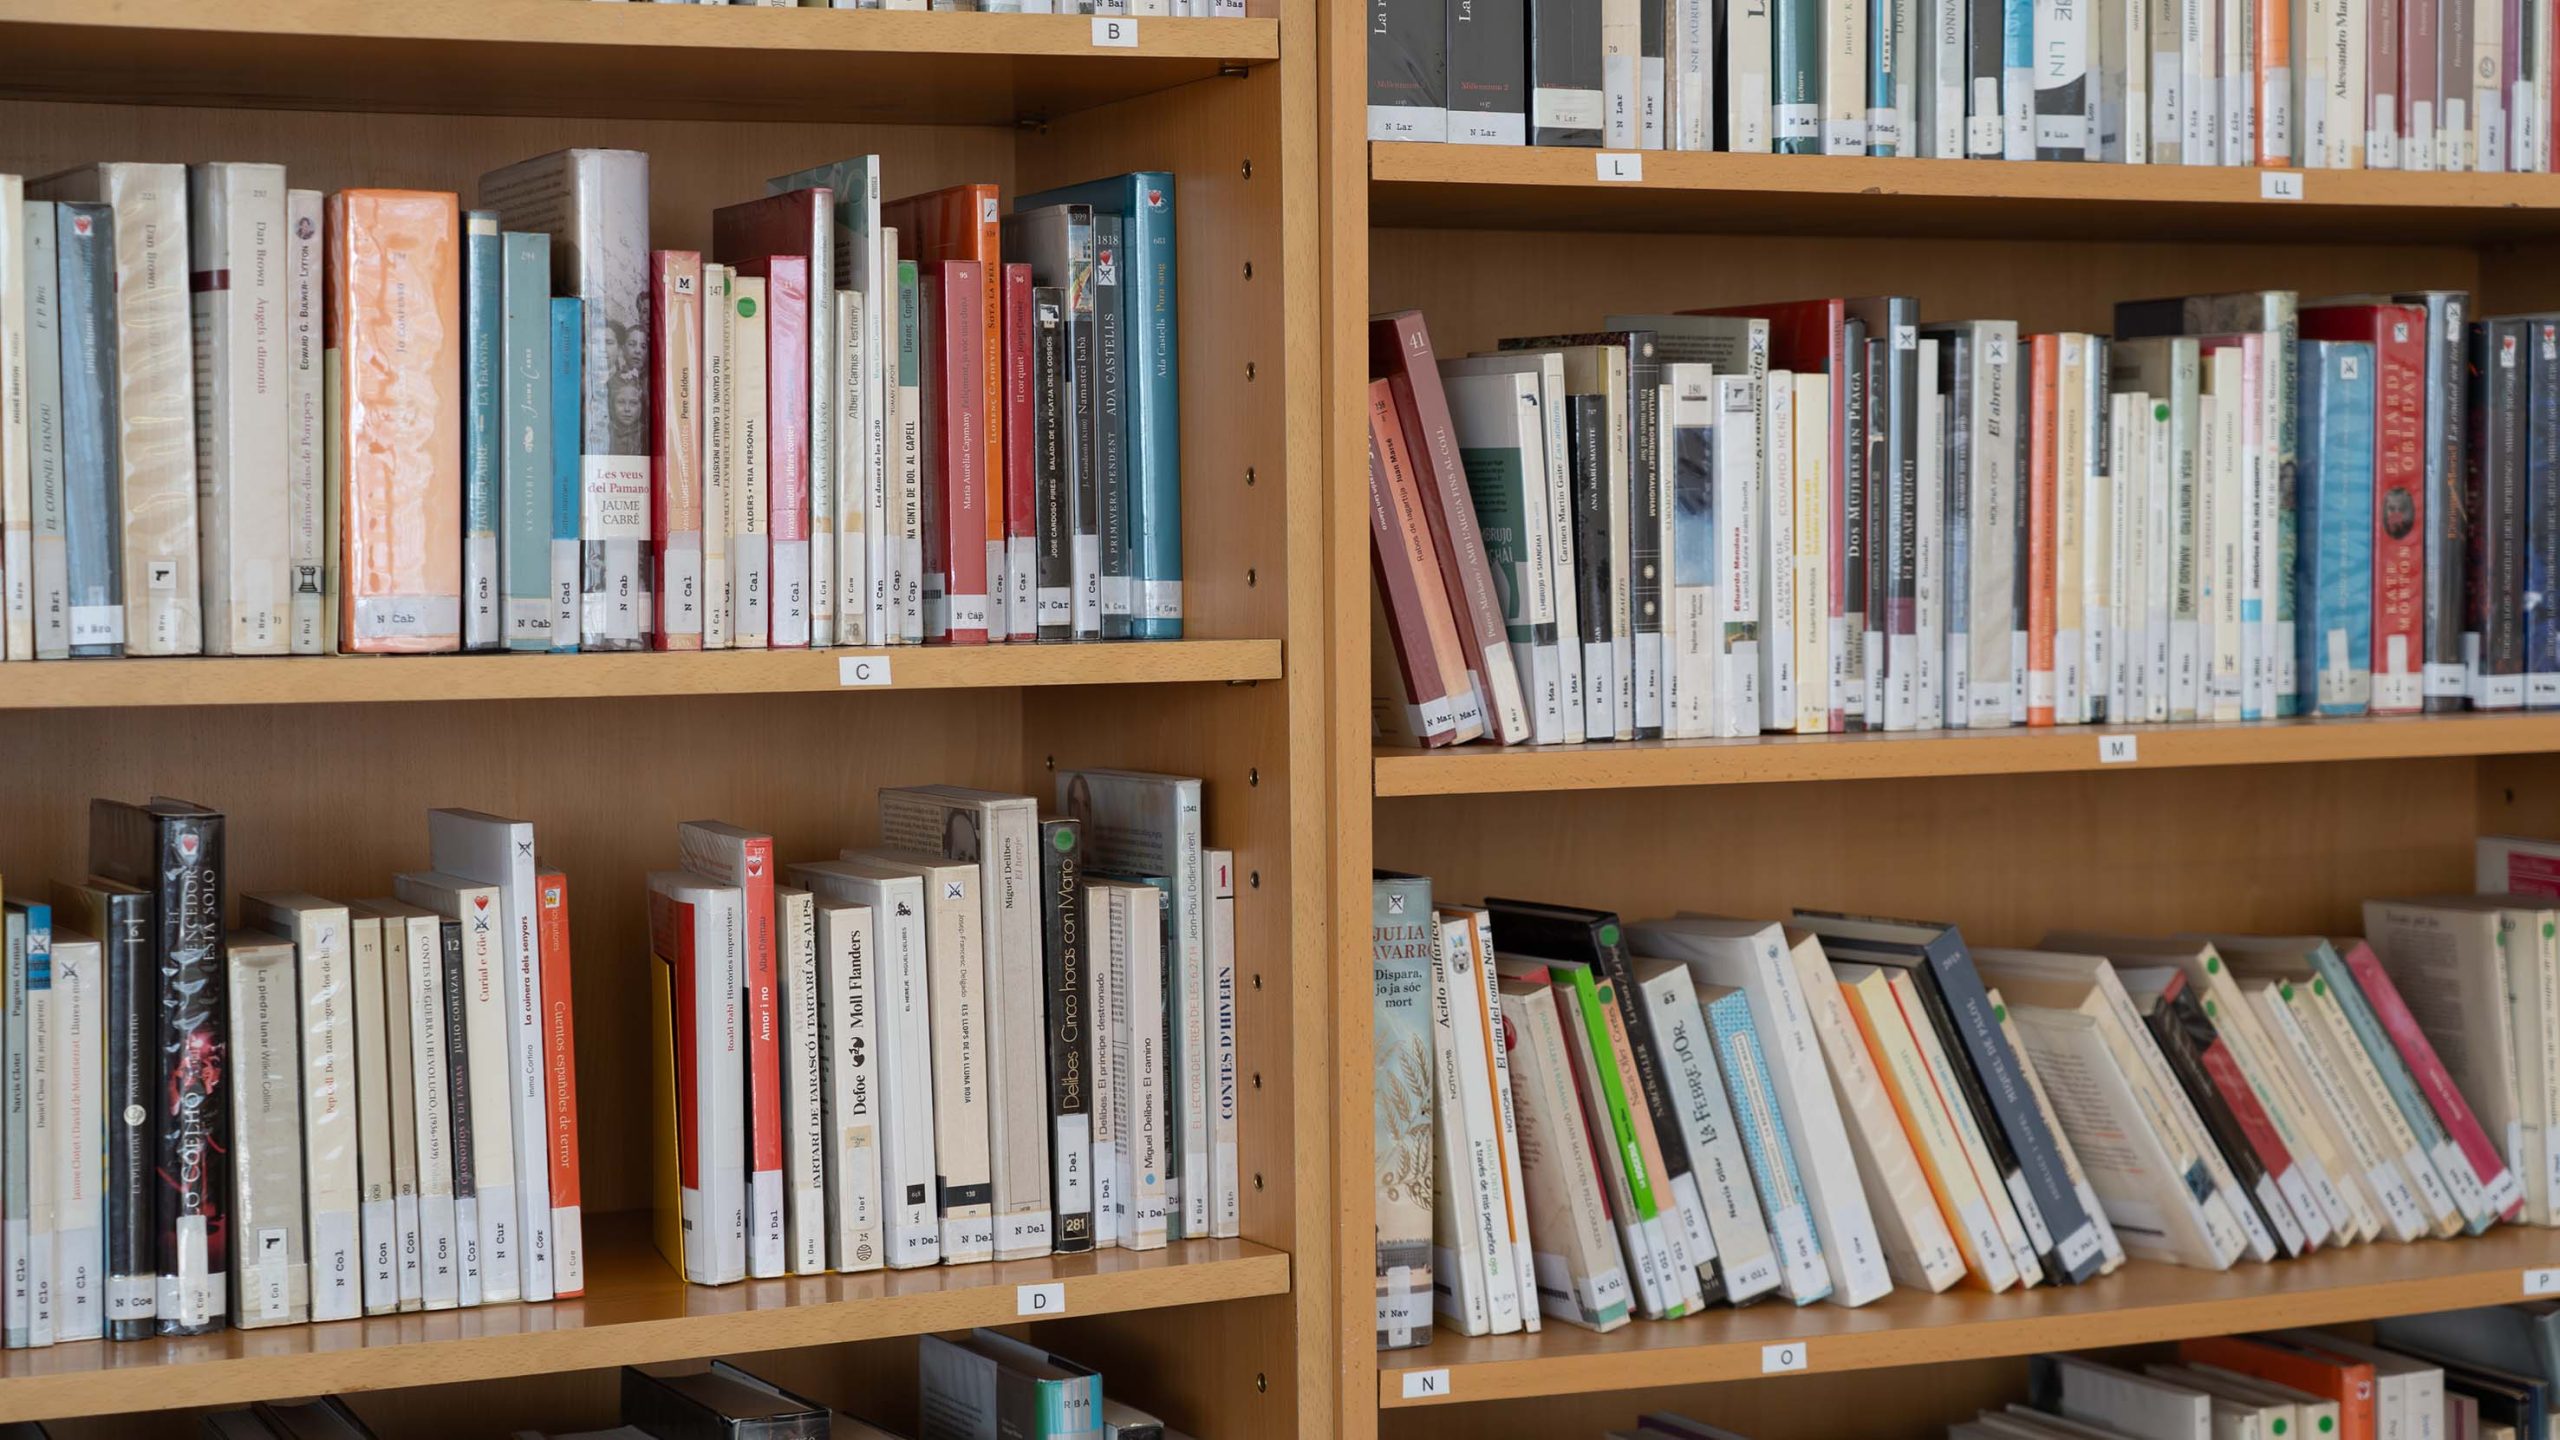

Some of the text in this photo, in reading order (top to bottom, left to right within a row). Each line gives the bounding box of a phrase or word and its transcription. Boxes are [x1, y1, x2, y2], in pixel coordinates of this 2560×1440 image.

[1108, 23, 1120, 39] B
[2339, 27, 2348, 100] Alessandro
[1615, 94, 1623, 116] Lar
[1645, 96, 1653, 117] Lar
[1385, 123, 1413, 131] N Lar
[1615, 160, 1624, 175] L
[2274, 180, 2291, 194] LL
[1097, 235, 1119, 245] 1818
[1156, 263, 1166, 377] Ada Castells Pura sang
[1409, 331, 1424, 349] 41
[680, 367, 688, 398] Calders
[1648, 389, 1656, 424] WILLIAM
[1048, 418, 1055, 428] LA
[1049, 430, 1055, 439] DE
[1104, 313, 1119, 573] LA PRIMAVERA PENDENT ADA CASTELLS
[1386, 438, 1398, 462] Marsé
[1554, 443, 1563, 461] Las
[962, 412, 972, 509] Maria Aurèlia Capmany
[1588, 427, 1598, 511] ANA MARÍA MATUTE
[1393, 464, 1404, 483] Juan
[1555, 464, 1564, 488] Gaite
[588, 482, 649, 493] del Pamano
[602, 500, 639, 511] JAUME
[1400, 487, 1414, 522] lagartija
[603, 512, 640, 525] CABRÉ
[1408, 523, 1416, 533] de
[1050, 539, 1058, 558] JOSÉ
[1558, 525, 1568, 562] Carmen
[619, 576, 627, 597] Cab
[684, 577, 692, 597] Cal
[791, 582, 799, 601] Cal
[855, 663, 870, 680] C
[2111, 742, 2124, 756] M
[1003, 837, 1014, 909] Miguel Delibes
[521, 916, 530, 953] senyors
[726, 907, 734, 958] imprevistes
[1373, 927, 1426, 942] JULIA
[448, 940, 459, 951] 12
[1371, 943, 1433, 960] AVARR
[521, 955, 530, 974] dels
[726, 961, 734, 999] Històries
[1058, 859, 1080, 1108] Delibes Cinco horas con Mario
[1374, 968, 1423, 983] Dispara,
[523, 977, 531, 1012] cuinera
[1376, 983, 1421, 997] jo ja sóc
[1385, 996, 1413, 1009] mort
[1436, 987, 1450, 1028] Ácido
[524, 1014, 532, 1025] La
[848, 930, 866, 1115] Defoe Moll Flanders
[1220, 966, 1233, 1119] CONTES D'HIVERN
[1983, 1039, 1996, 1055] DE
[527, 1076, 535, 1097] Imma
[554, 1001, 570, 1168] Cuentos españoles de terror
[1143, 1037, 1154, 1168] Miguel Delibes: El camino
[181, 1092, 200, 1182] COELHO
[1069, 1152, 1077, 1172] Del
[1480, 1180, 1490, 1191] de
[1482, 1194, 1491, 1210] mis
[1067, 1218, 1085, 1232] 281
[1482, 1212, 1495, 1256] pequeños
[406, 1232, 414, 1253] Con
[468, 1240, 476, 1261] Cor
[336, 1250, 344, 1271] Col
[379, 1243, 387, 1264] Con
[438, 1237, 447, 1274] N Con
[1488, 1257, 1499, 1276] ojos
[2540, 1275, 2549, 1288] P
[1034, 1293, 1047, 1309] D
[1379, 1310, 1408, 1319] N Nav
[1780, 1350, 1793, 1365] O
[1422, 1377, 1434, 1392] N
